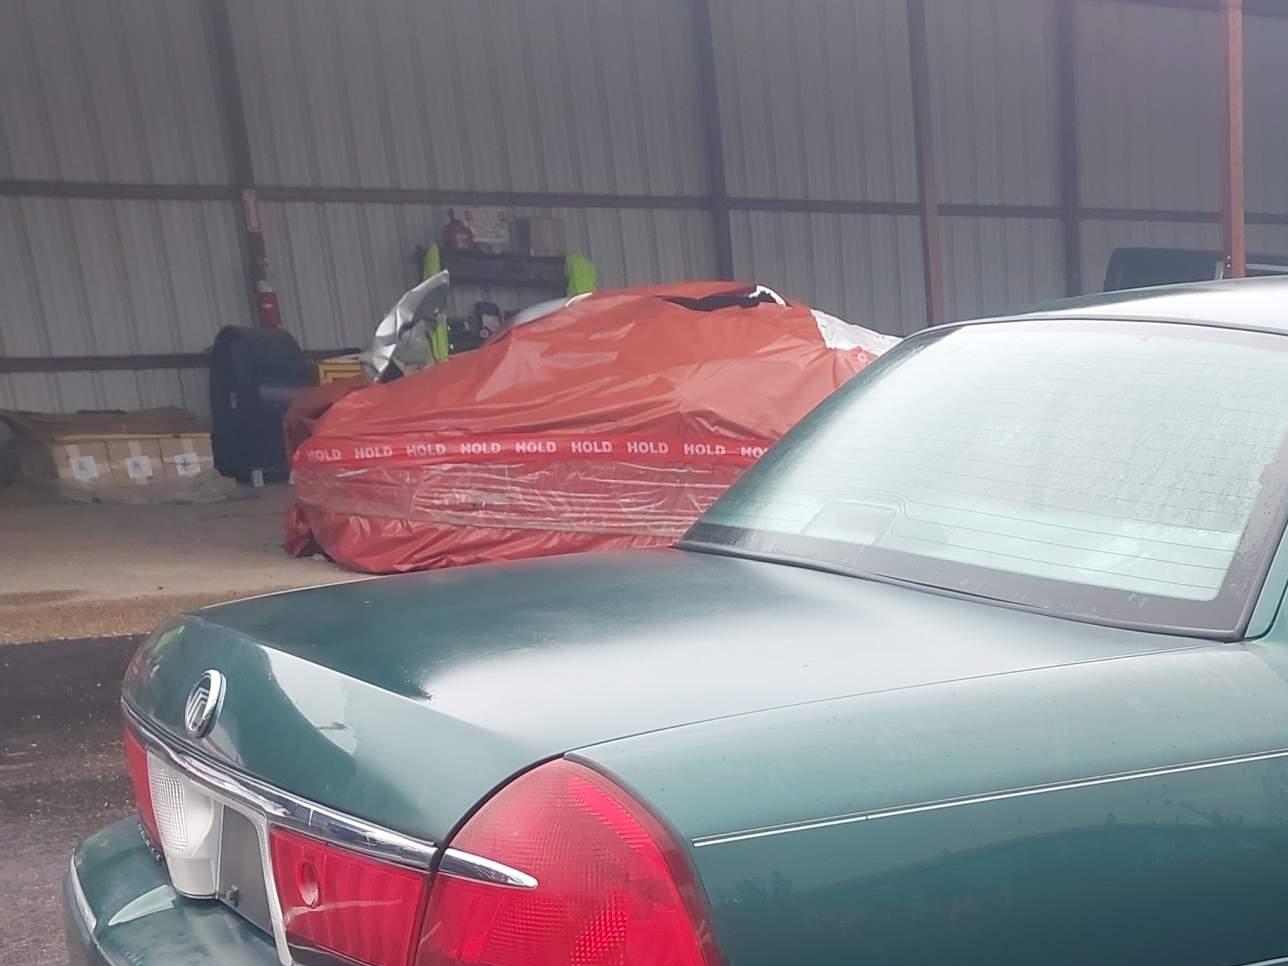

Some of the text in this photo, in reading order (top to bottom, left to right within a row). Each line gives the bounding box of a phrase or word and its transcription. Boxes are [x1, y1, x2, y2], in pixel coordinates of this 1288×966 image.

[354, 446, 393, 459] HOLD
[406, 443, 446, 457] HOLD
[460, 442, 502, 455] HOLD
[515, 440, 557, 453] HOLD
[571, 441, 613, 454] HOLD
[627, 441, 669, 455] HOLD
[683, 443, 727, 456] HOLD
[740, 446, 769, 458] HO
